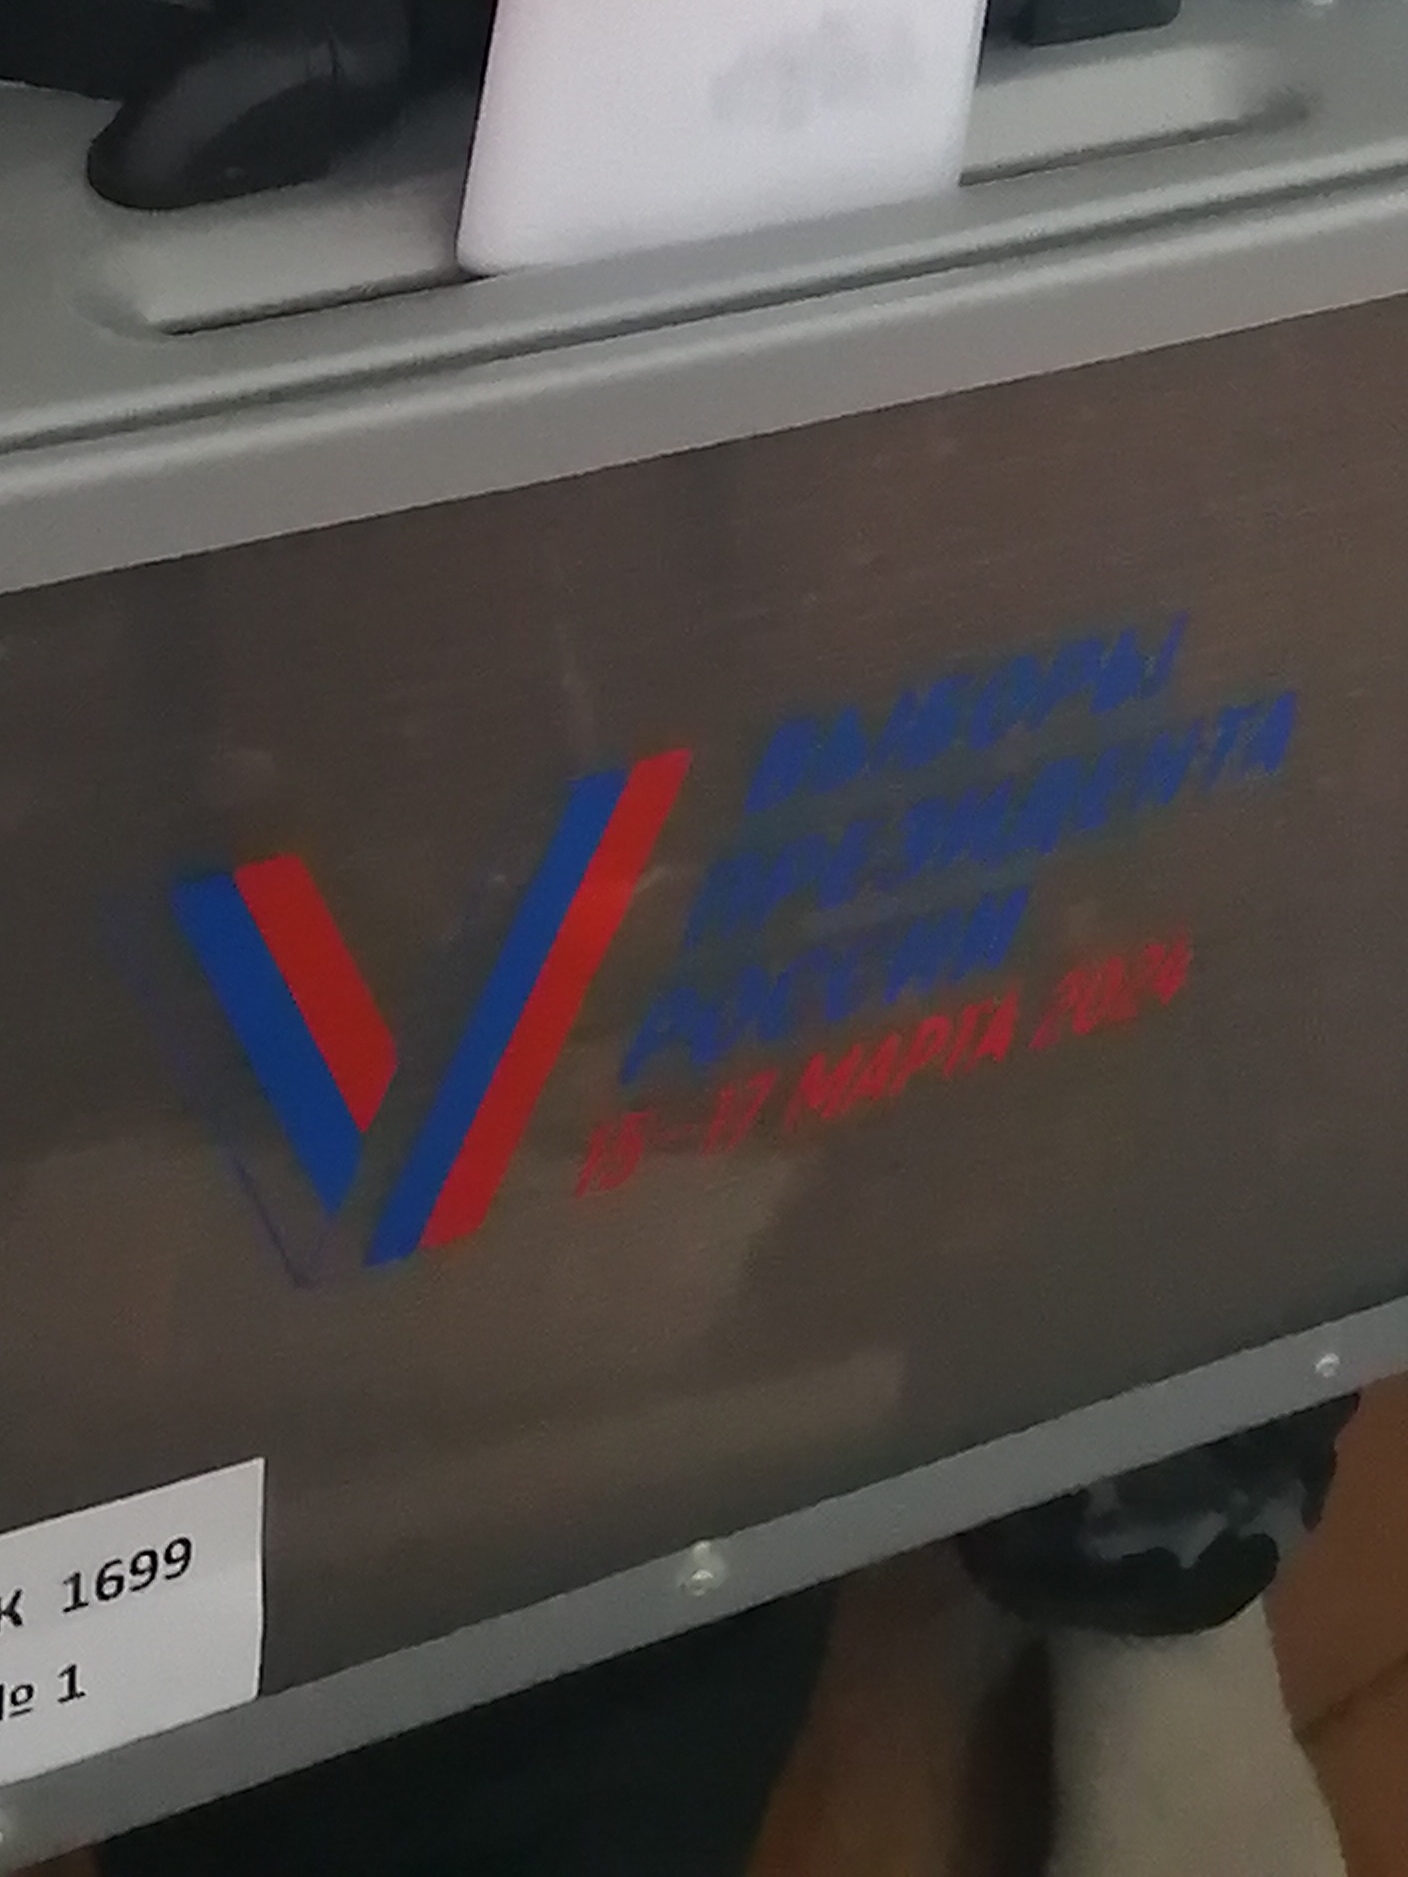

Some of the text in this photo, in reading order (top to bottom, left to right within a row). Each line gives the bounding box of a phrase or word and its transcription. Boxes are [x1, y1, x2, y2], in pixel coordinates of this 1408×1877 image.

[783, 985, 1022, 1131] МАРТА
[61, 1536, 194, 1615] 1699
[56, 1664, 87, 1704] 1
